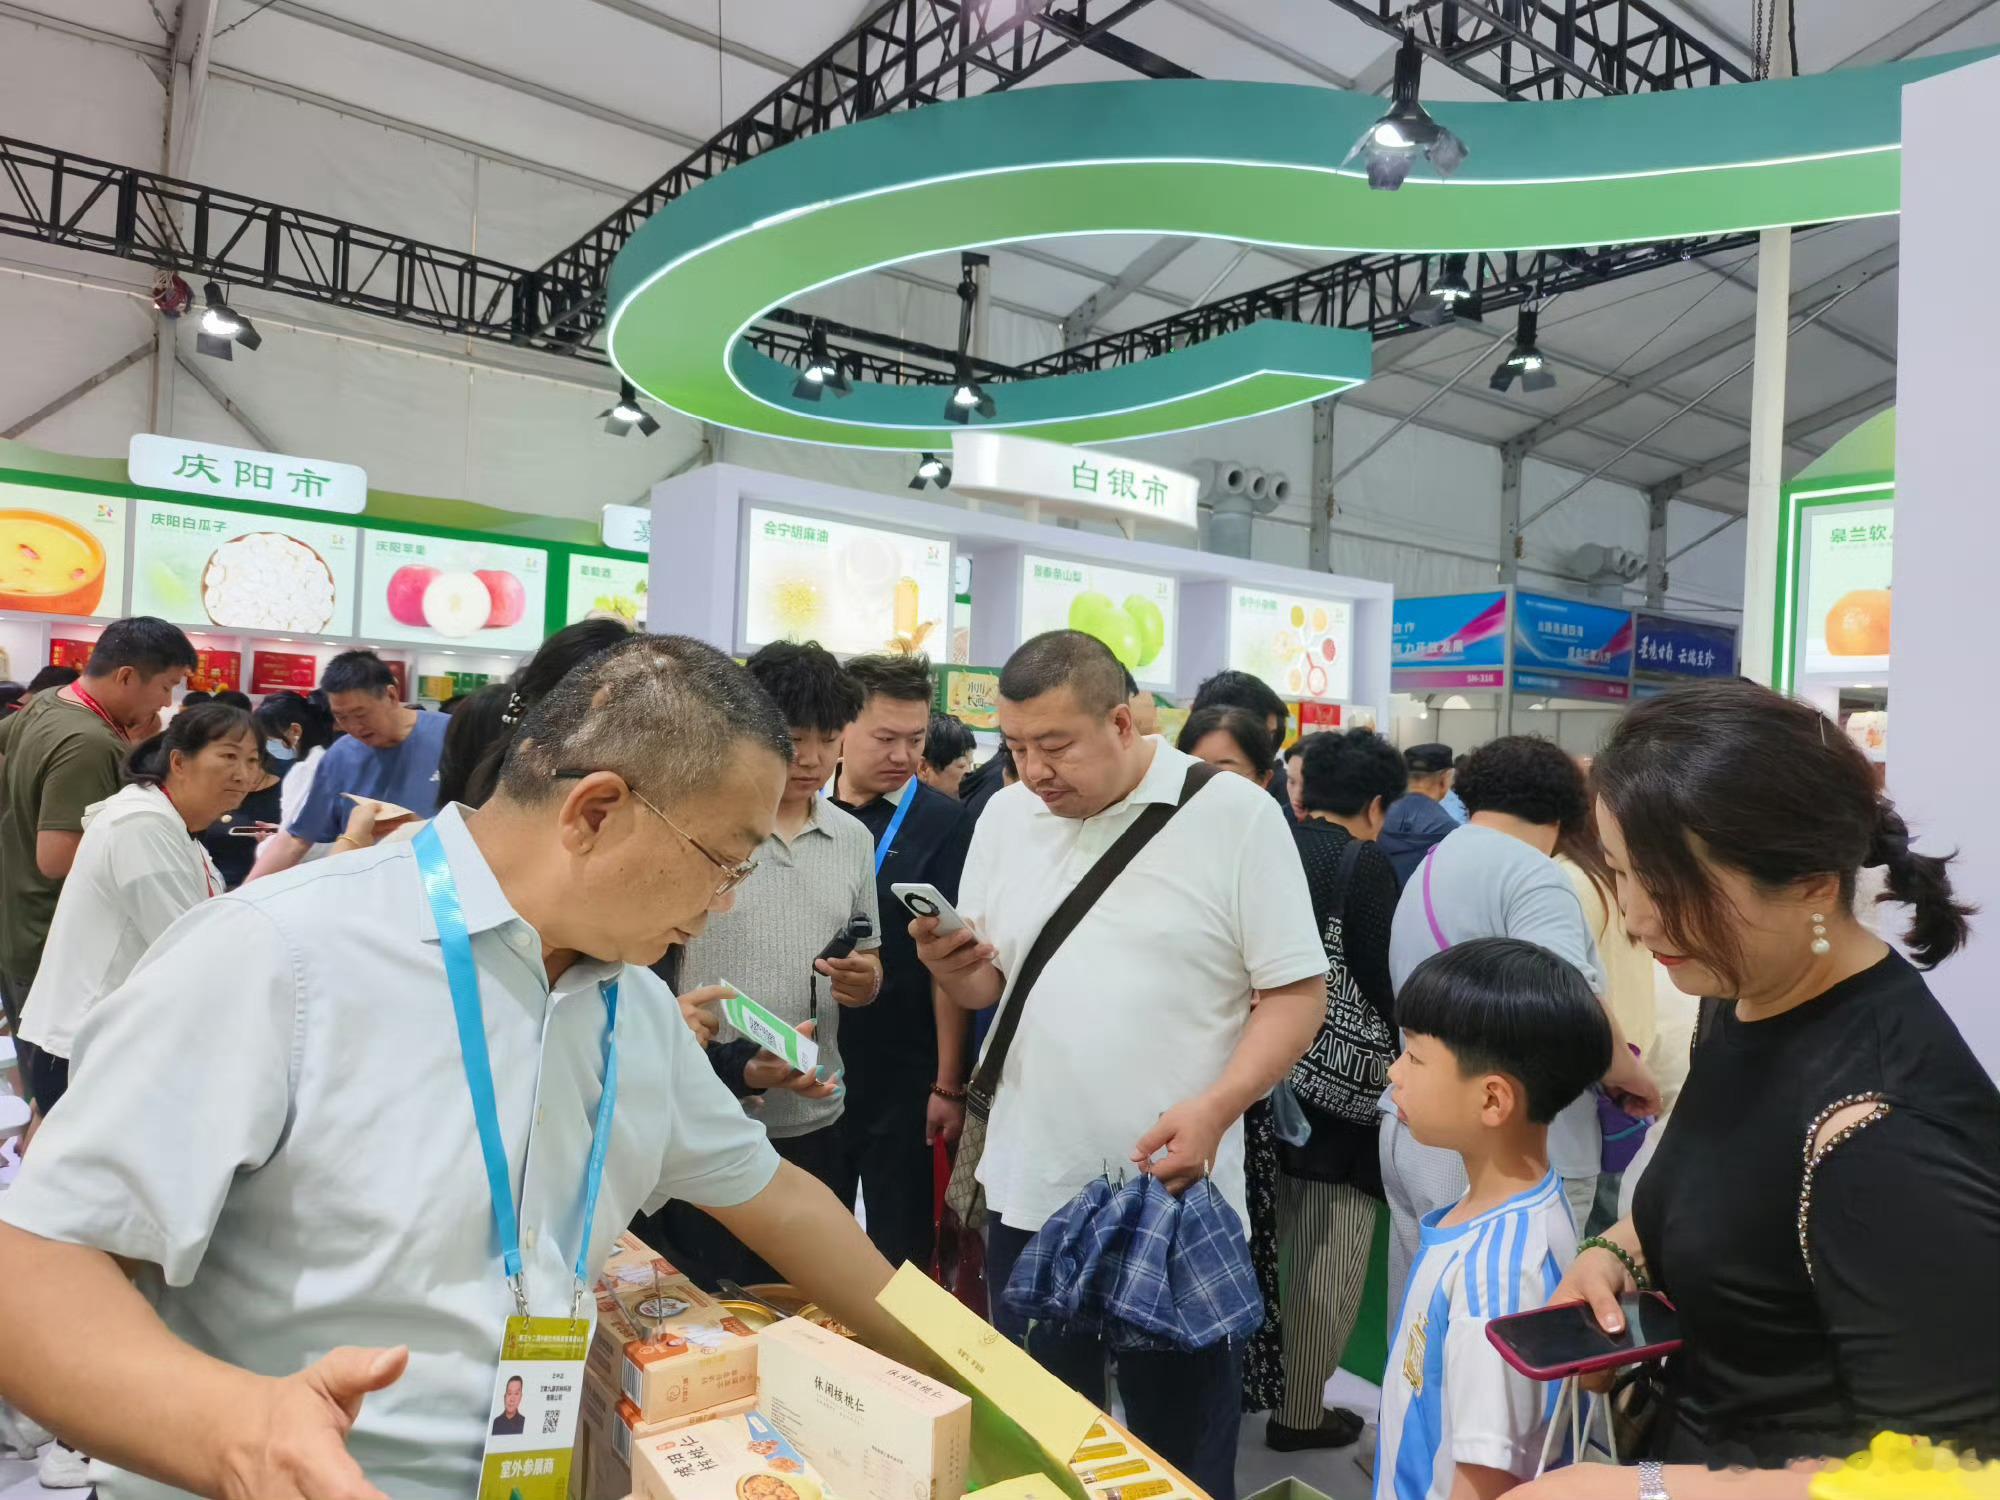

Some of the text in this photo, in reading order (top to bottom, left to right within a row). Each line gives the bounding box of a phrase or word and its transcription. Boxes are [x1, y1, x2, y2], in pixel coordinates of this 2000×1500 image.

[172, 453, 332, 498] 庆阳市
[1072, 459, 1169, 507] 白银市
[151, 513, 227, 533] 庆阳白瓜子
[764, 520, 829, 544] 会宁胡麻油
[1831, 524, 1893, 543] 皋兰软
[375, 540, 427, 556] 庆阳苹果
[814, 1375, 865, 1413] 休闲核桃仁
[886, 1368, 945, 1399] 休闲核桃仁
[499, 1457, 555, 1480] 室外参展商
